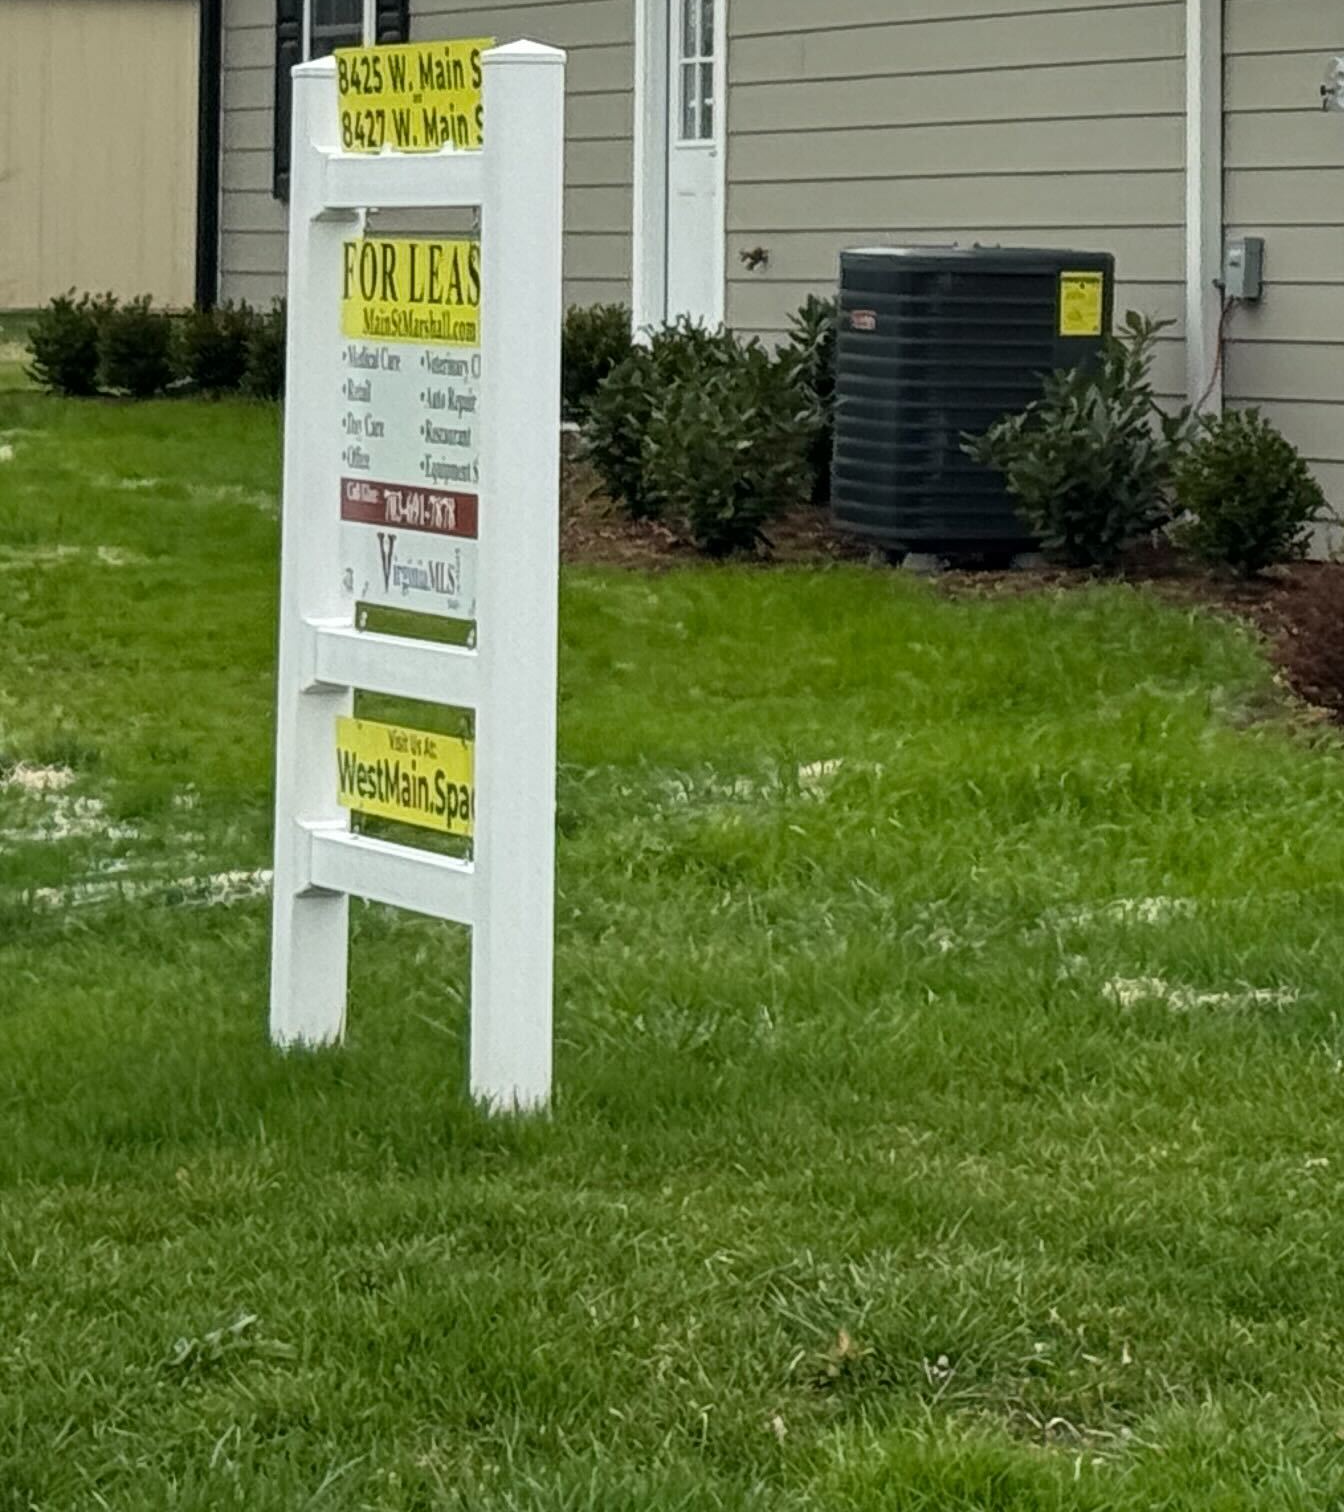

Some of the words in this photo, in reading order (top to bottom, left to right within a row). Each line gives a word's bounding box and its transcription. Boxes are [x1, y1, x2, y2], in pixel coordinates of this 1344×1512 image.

[338, 55, 384, 95] 8425
[387, 53, 414, 93] W.
[417, 46, 465, 90] Main
[469, 48, 482, 89] S
[341, 109, 385, 149] 8427
[391, 107, 418, 147] W.
[423, 102, 469, 147] Main
[474, 103, 484, 145] S
[343, 242, 399, 302] FOR
[408, 243, 481, 308] LEAS
[362, 306, 477, 342] MainStMarshall.com
[336, 747, 475, 830] WestMain.Spa
